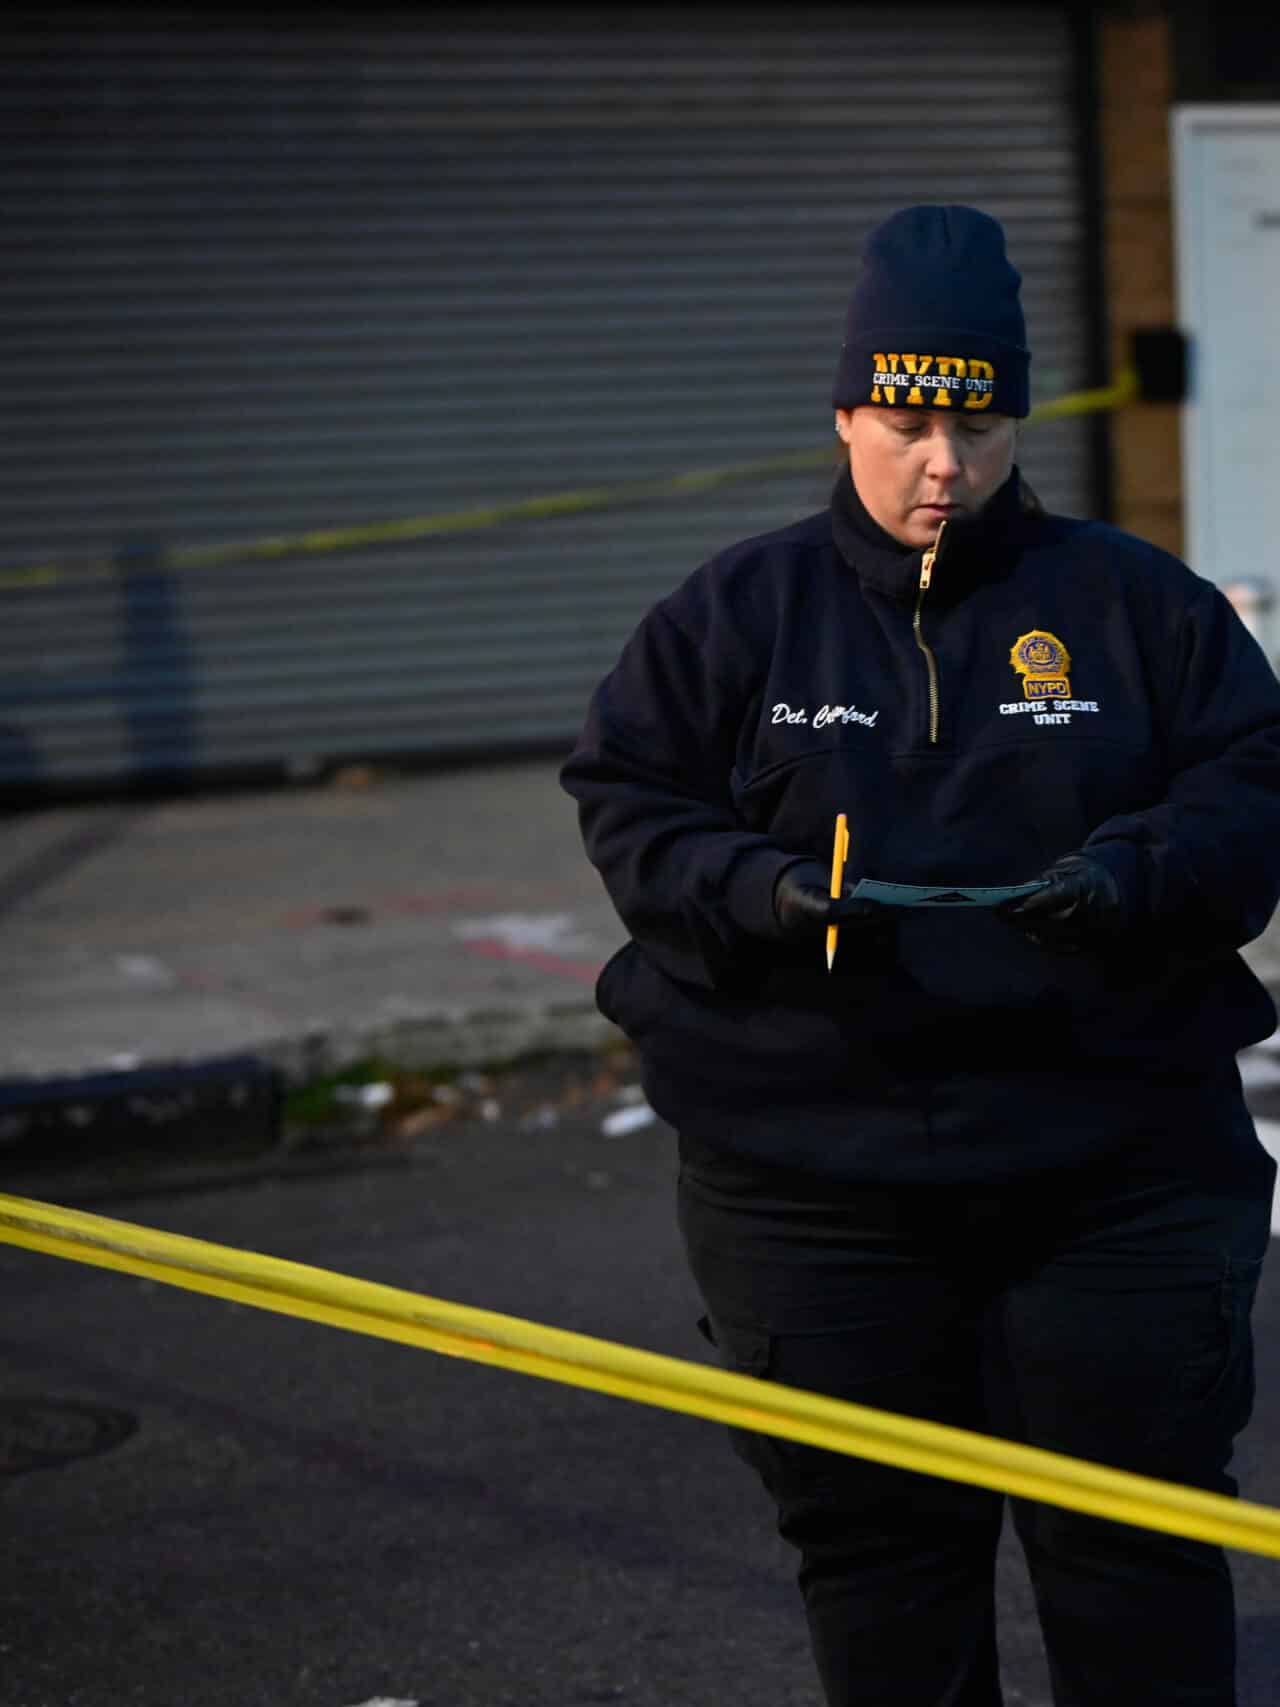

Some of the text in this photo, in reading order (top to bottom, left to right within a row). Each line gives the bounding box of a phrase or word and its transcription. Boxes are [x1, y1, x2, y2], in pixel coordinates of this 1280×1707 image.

[870, 352, 995, 410] NYPD
[872, 373, 994, 393] CRIME SCENE UNIT
[1028, 682, 1067, 697] NYPD
[771, 702, 808, 725] Det.
[999, 700, 1100, 715] CRIME SCENE
[1032, 713, 1072, 726] UNIT
